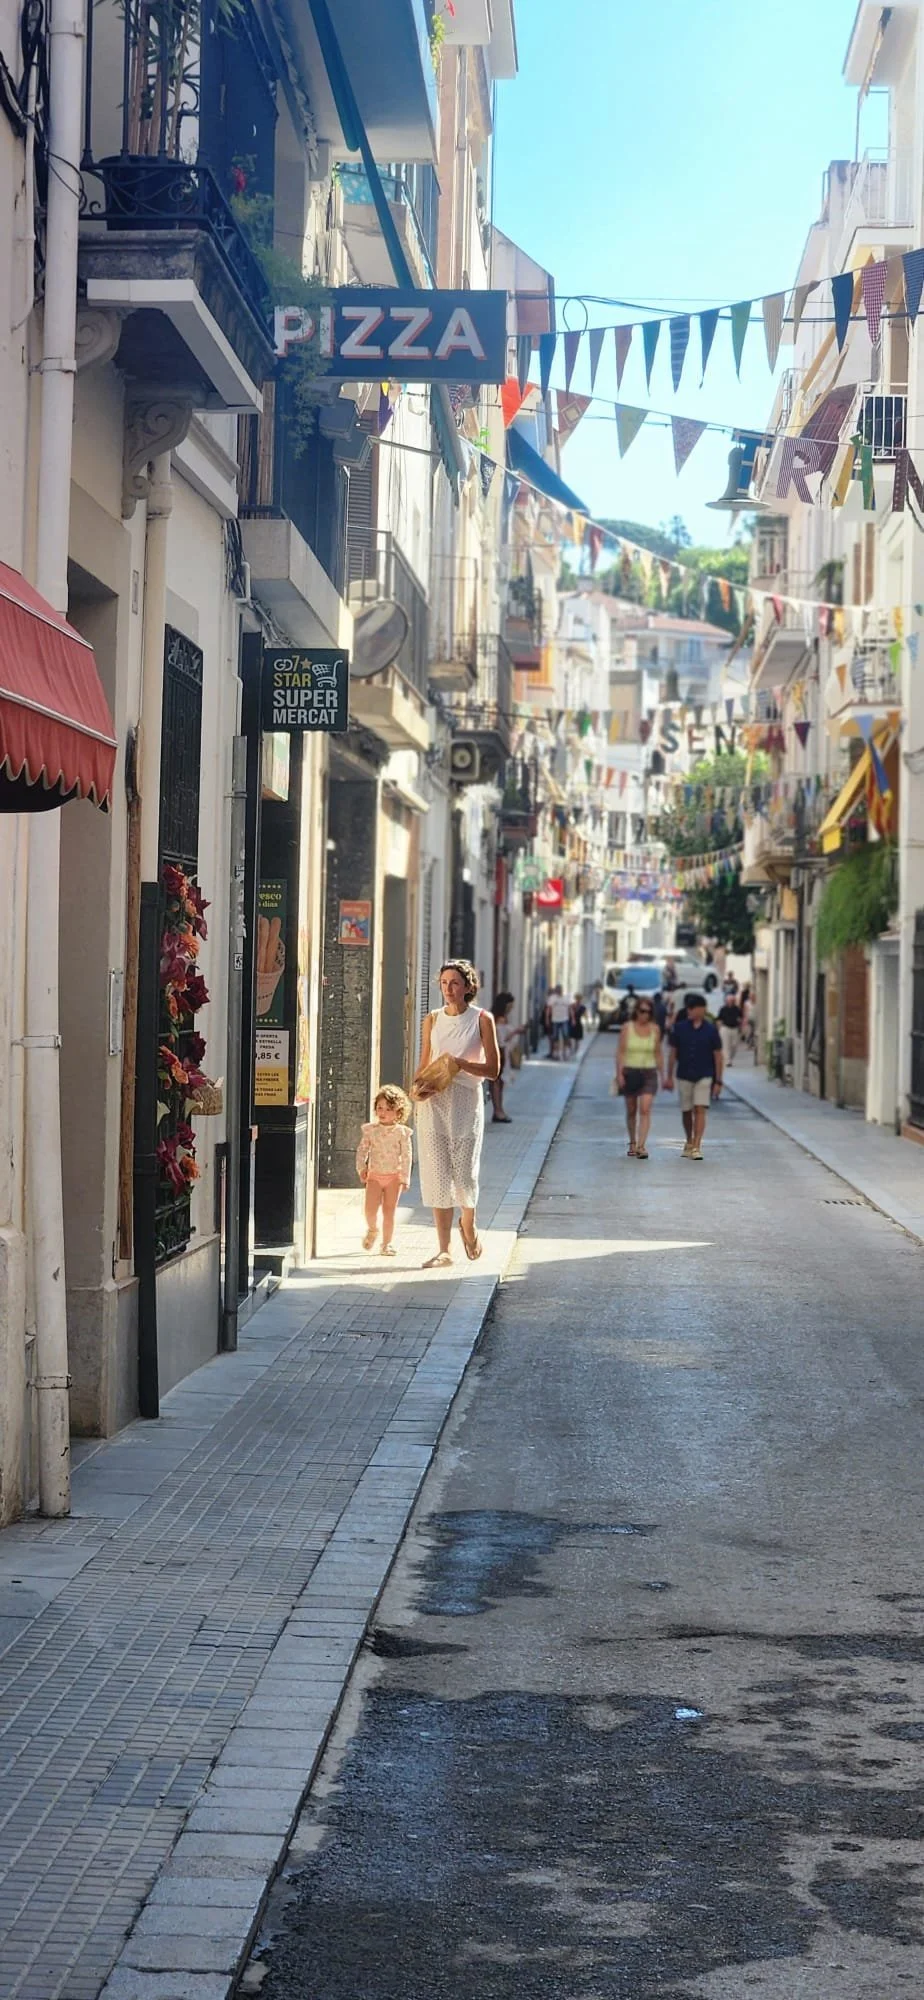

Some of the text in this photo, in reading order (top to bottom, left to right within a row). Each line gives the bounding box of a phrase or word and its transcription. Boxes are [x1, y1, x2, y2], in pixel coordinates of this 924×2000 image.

[273, 305, 487, 360] PIZZA
[273, 673, 312, 687] STAR
[273, 689, 338, 708] SUPER
[273, 708, 338, 724] MERCAT
